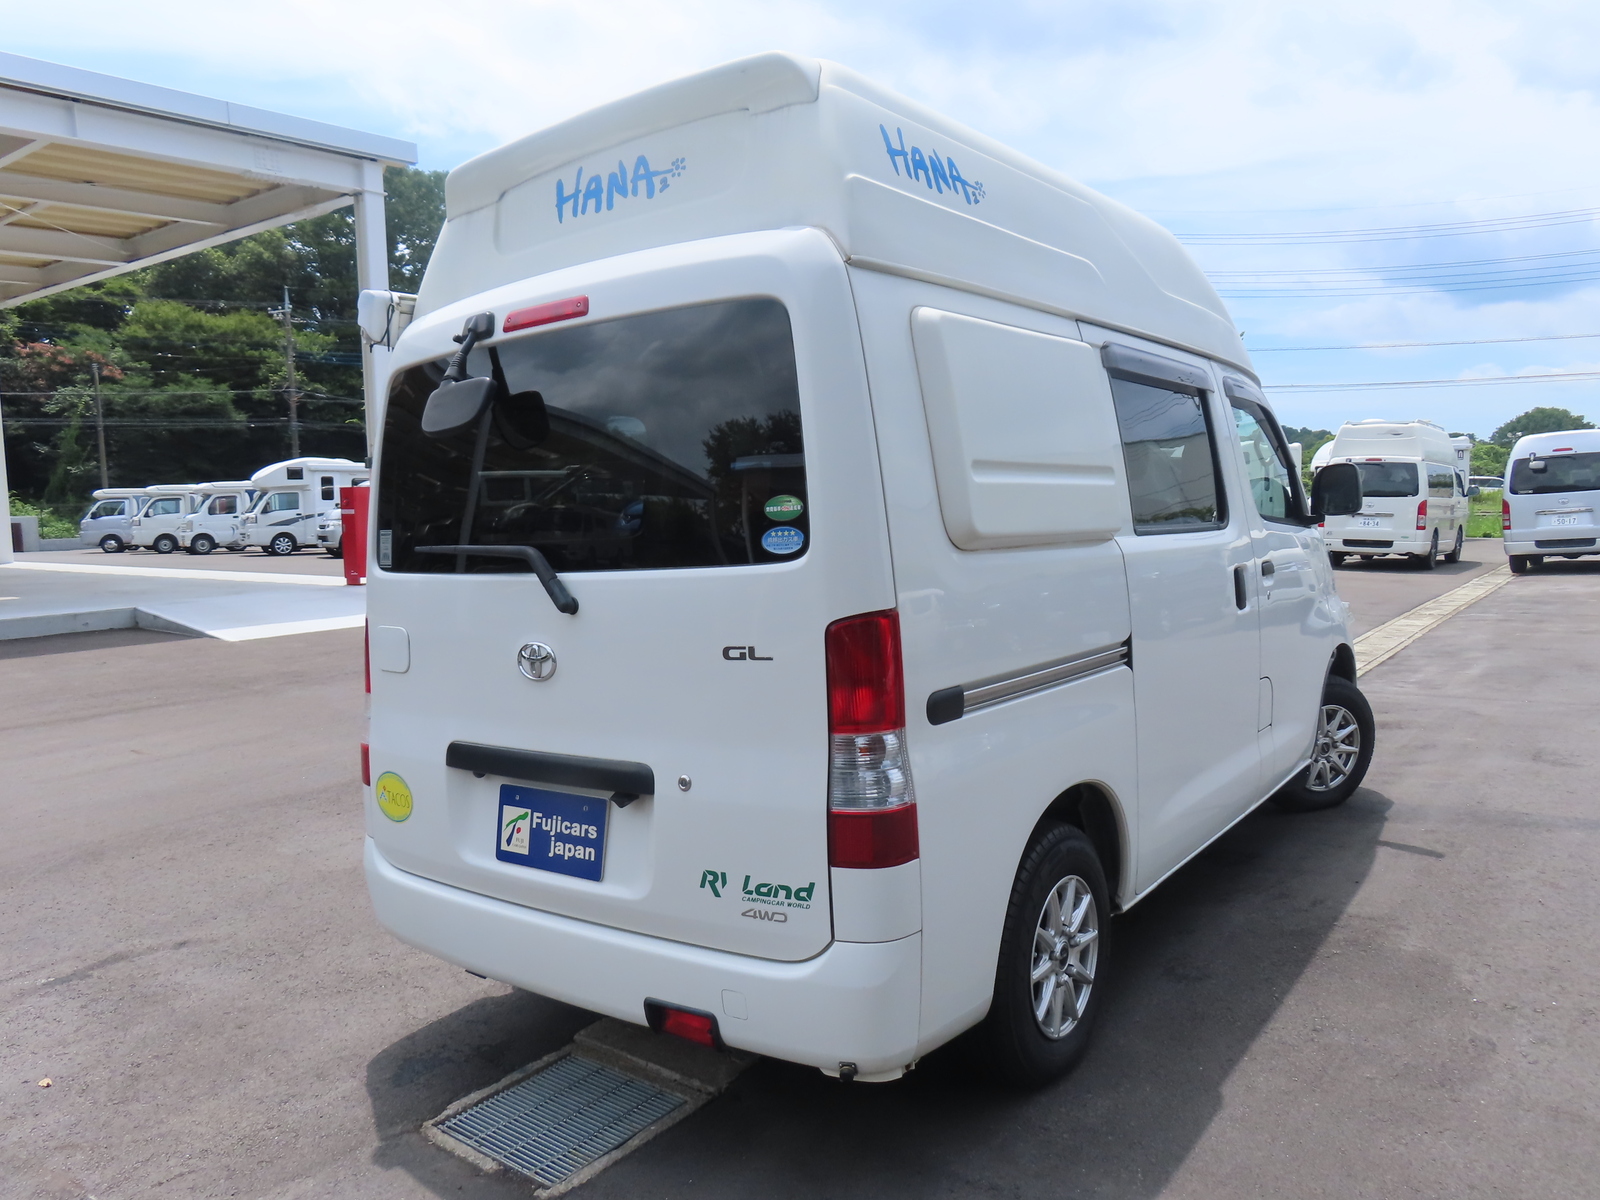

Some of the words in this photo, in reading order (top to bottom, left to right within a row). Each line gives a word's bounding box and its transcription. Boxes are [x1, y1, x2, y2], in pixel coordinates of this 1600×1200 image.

[879, 123, 978, 205] HANA
[555, 154, 674, 224] HANA
[722, 645, 774, 661] GL
[532, 811, 598, 839] Fujicars
[548, 836, 595, 861] japan
[742, 874, 816, 902] Land
[741, 896, 785, 907] CAMPINGCAR
[787, 901, 811, 910] WORLD
[741, 908, 788, 923] 4WD
